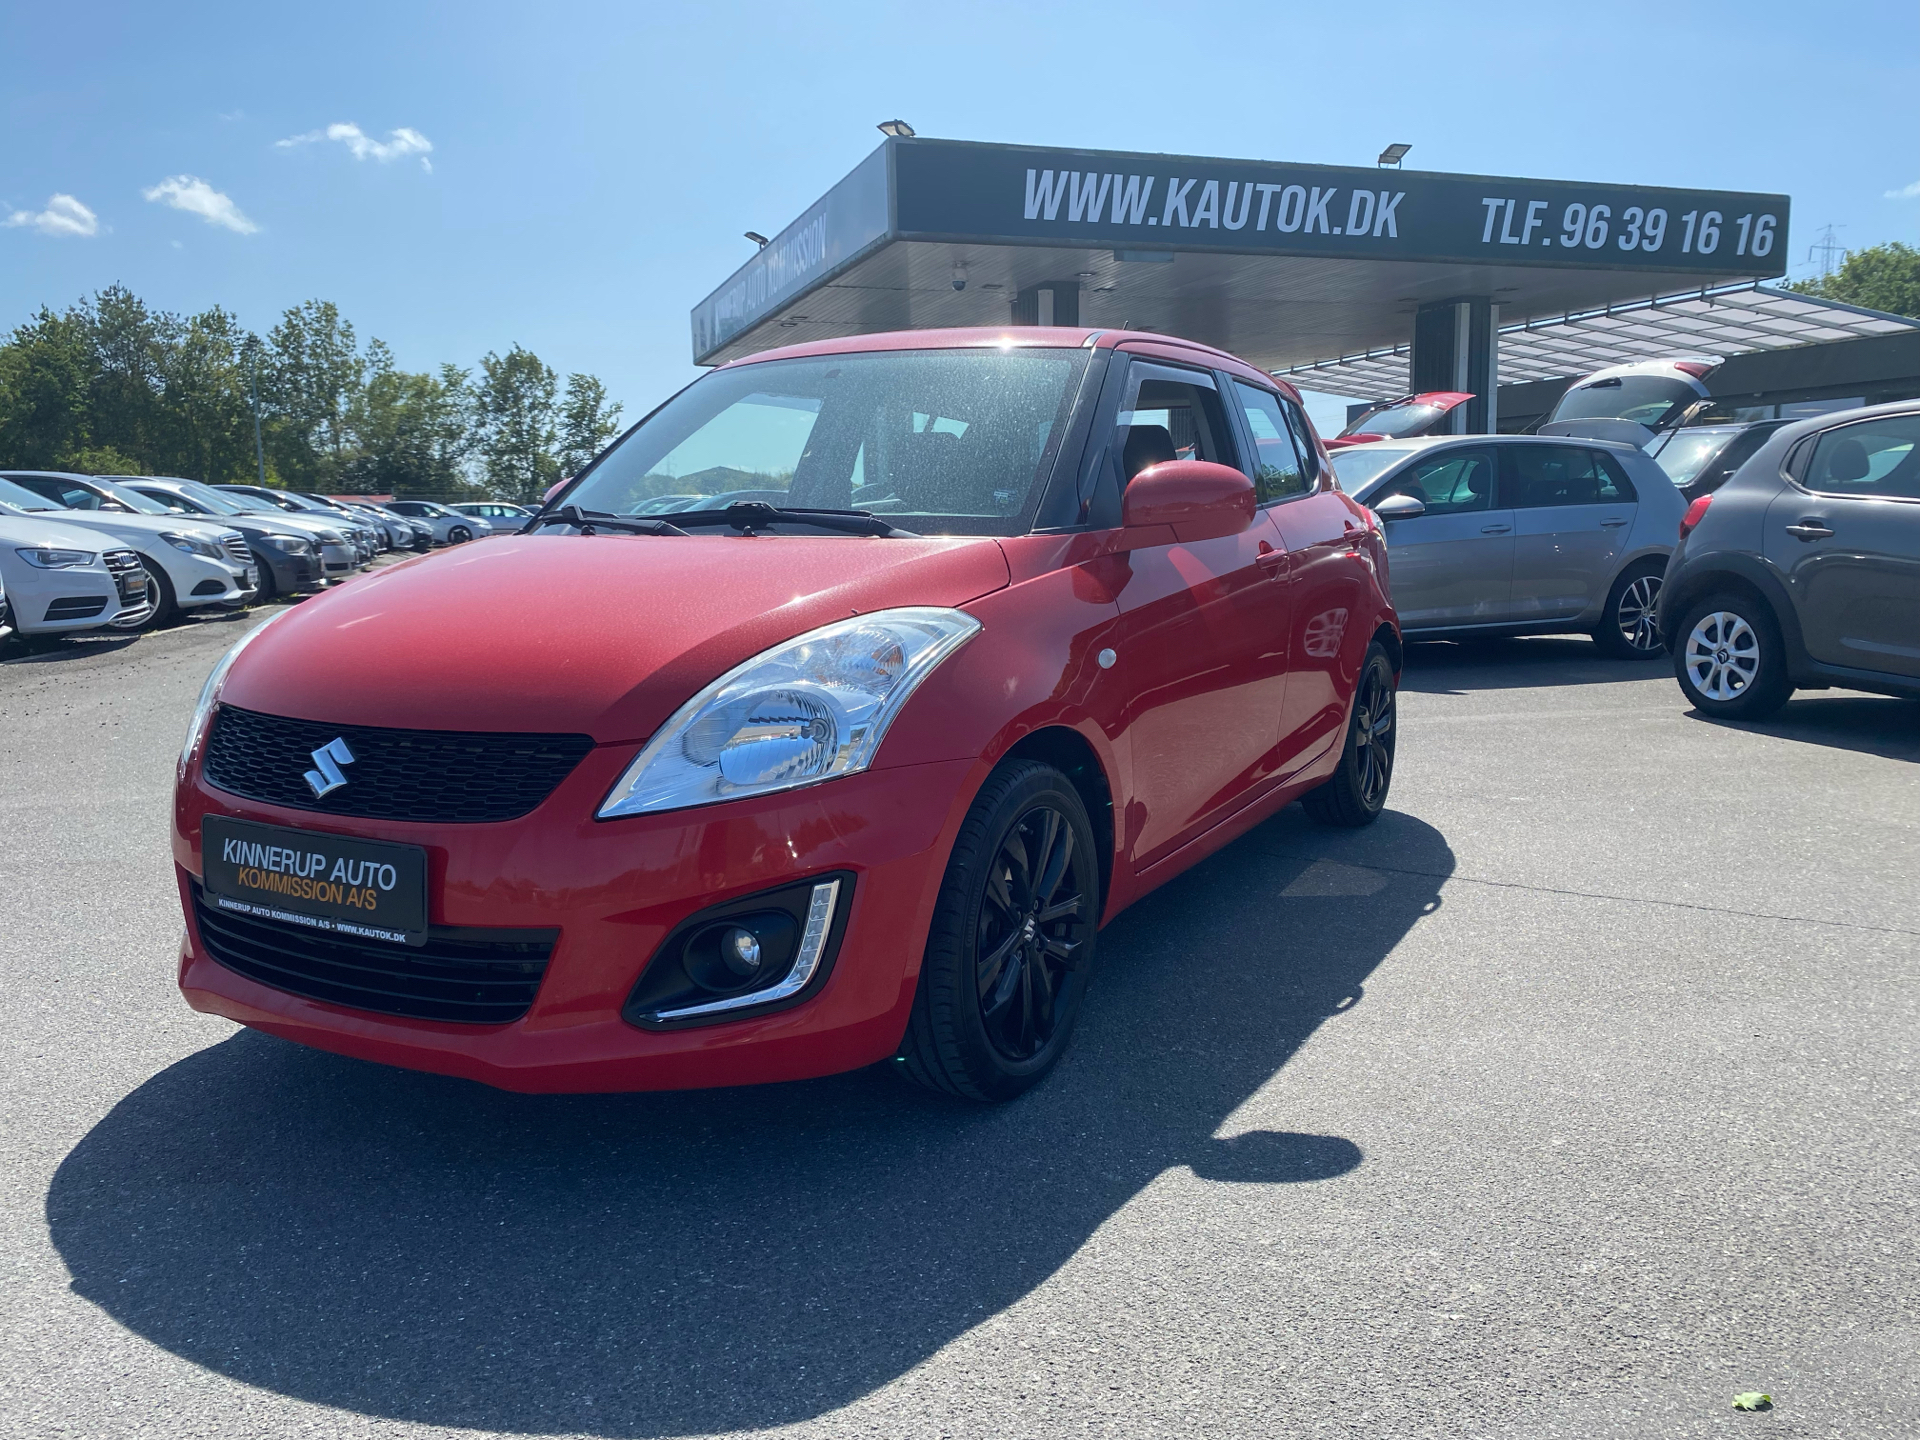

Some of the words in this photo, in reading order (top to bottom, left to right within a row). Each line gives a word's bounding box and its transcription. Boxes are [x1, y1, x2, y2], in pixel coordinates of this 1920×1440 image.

[1024, 168, 1406, 238] WWW.KAUTOK.DK
[1482, 197, 1551, 246] TLF.
[1560, 202, 1611, 249] 96
[1618, 206, 1668, 252] 39
[1681, 210, 1723, 255] 16
[1736, 213, 1777, 257] 16
[746, 264, 766, 312] AUTO
[768, 213, 827, 298] KOMMISSION
[222, 838, 326, 878] KINNERUP
[329, 857, 397, 891] AUTO
[238, 867, 343, 904] KOMMISSION
[346, 887, 377, 910] A/S
[218, 898, 251, 912] KINNERUP
[252, 906, 270, 917] AUTO
[271, 910, 317, 926] KOMMISSION
[318, 919, 330, 929] A/S
[336, 923, 406, 943] WWW.KAUTOK.DK
